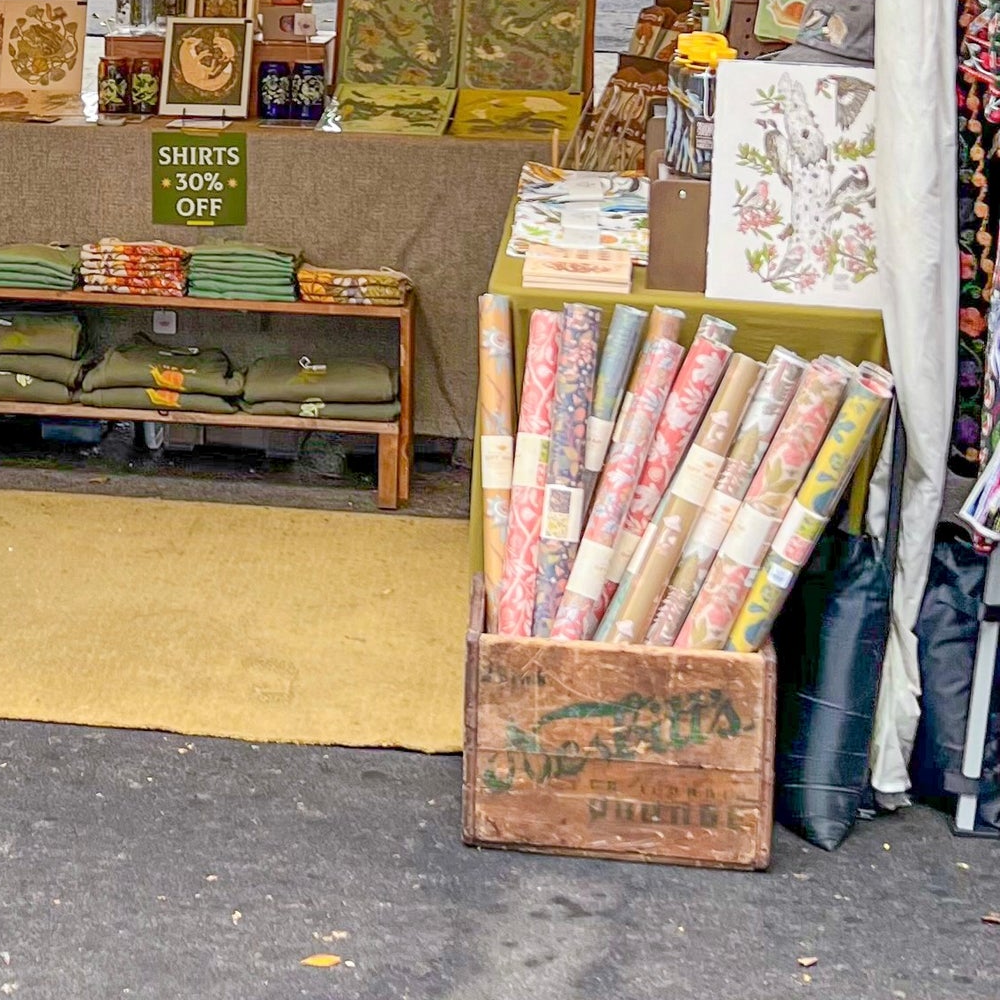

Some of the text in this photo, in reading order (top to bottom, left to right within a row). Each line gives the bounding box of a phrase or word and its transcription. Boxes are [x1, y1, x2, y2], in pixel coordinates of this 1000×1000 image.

[158, 146, 240, 166] SHIRTS
[175, 172, 224, 192] 30%
[176, 197, 223, 217] OFF
